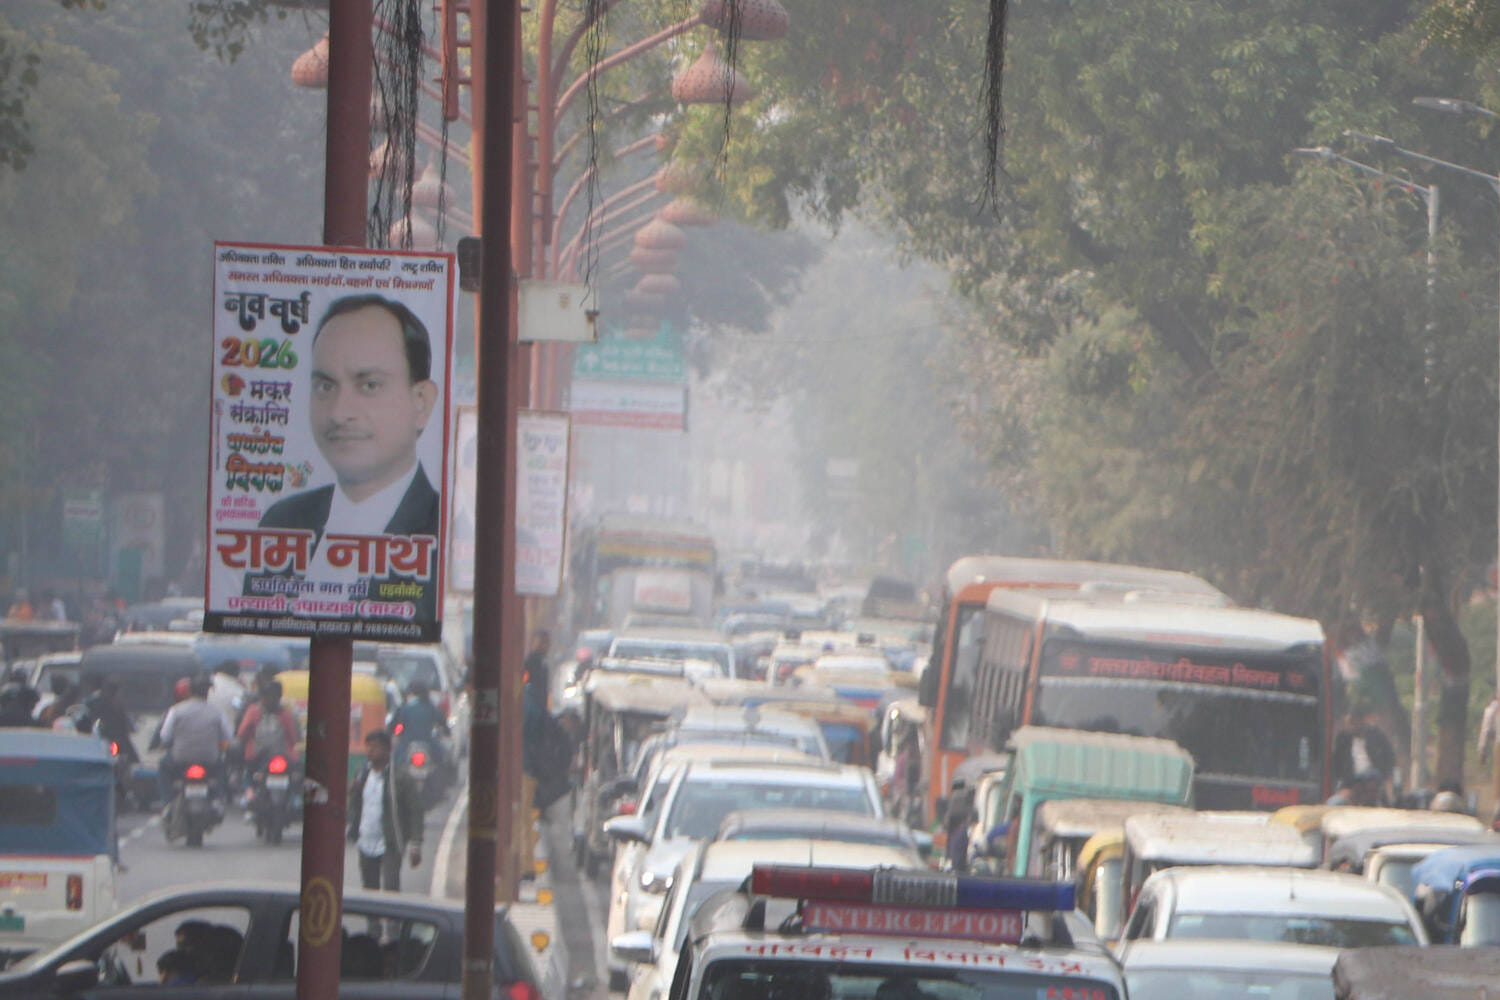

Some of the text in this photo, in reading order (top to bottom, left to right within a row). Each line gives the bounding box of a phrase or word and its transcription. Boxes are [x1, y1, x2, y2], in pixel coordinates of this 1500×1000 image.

[224, 290, 311, 334] नव वर्ष
[220, 336, 299, 370] 2026
[250, 380, 293, 403] मकर
[216, 528, 434, 576] राम नाथ
[811, 906, 1019, 936] INTERCEPTOR
